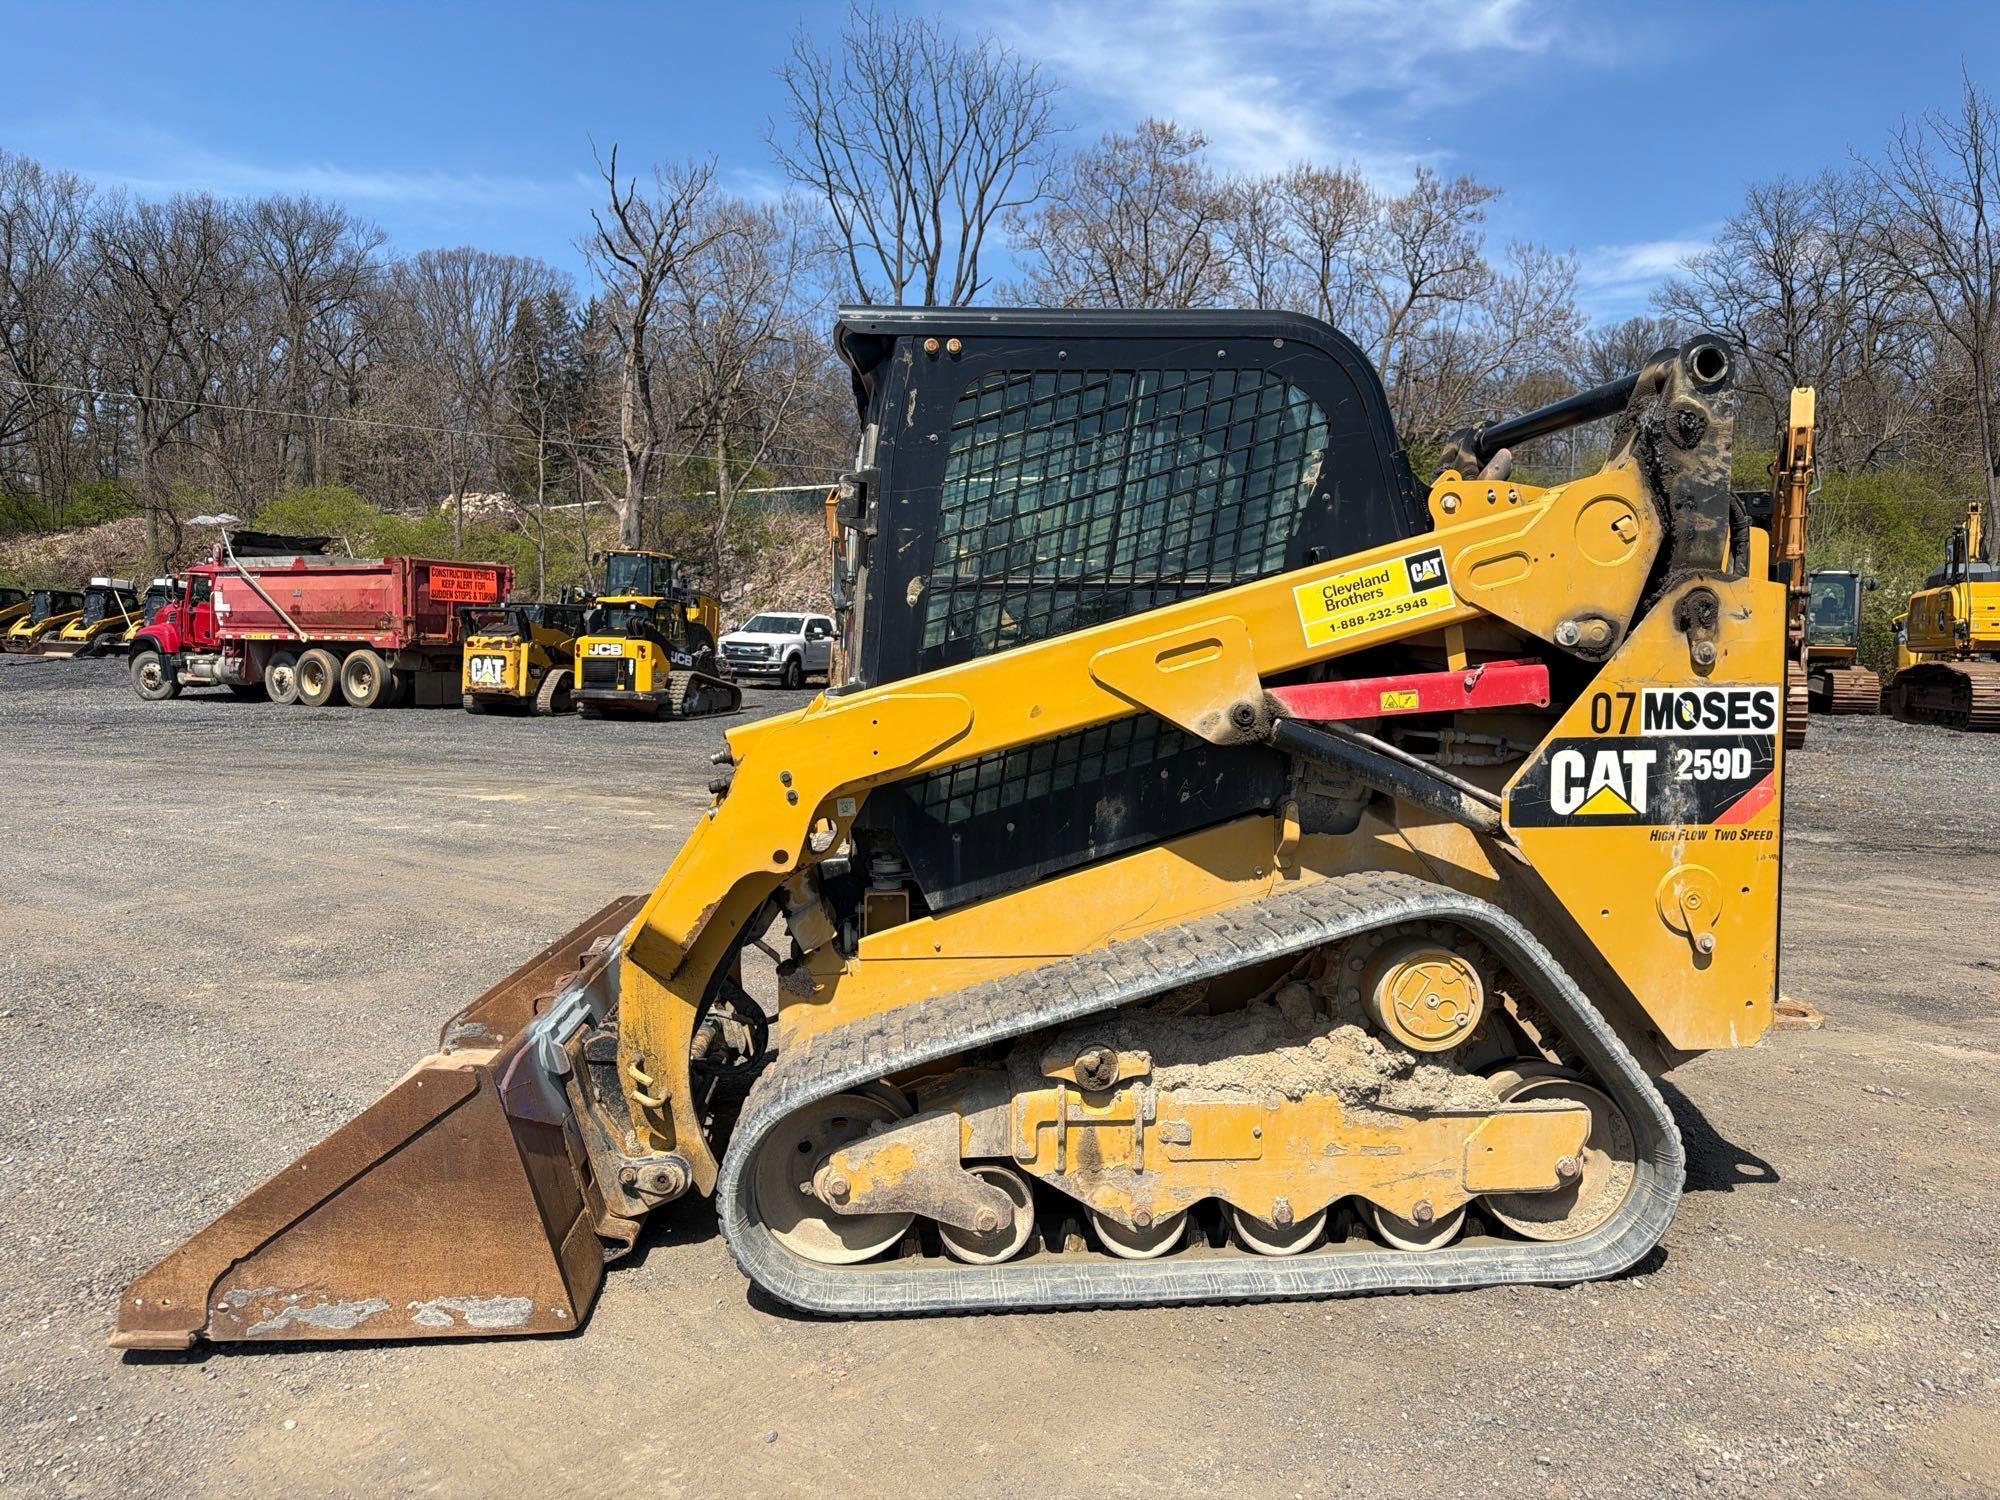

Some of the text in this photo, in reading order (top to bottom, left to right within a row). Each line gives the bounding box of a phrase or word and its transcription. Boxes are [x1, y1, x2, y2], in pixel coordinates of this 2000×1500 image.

[431, 567, 495, 581] CONSTRUCTION VEHICLE
[1410, 557, 1442, 583] CAT
[431, 589, 497, 601] SUDDEN STOPS & TURNS
[441, 579, 486, 591] KEEP ALERT FOR
[1322, 569, 1390, 600] Cleveland
[1324, 587, 1384, 612] Brothers
[1329, 597, 1428, 632] 1-888-232-5948
[588, 643, 622, 656] JCB
[670, 650, 693, 667] JCB
[471, 655, 504, 683] CAT
[1590, 692, 1637, 735] 07
[1644, 690, 1775, 731] MOSES
[1674, 748, 1752, 781] 259D
[1550, 749, 1656, 816] CAT
